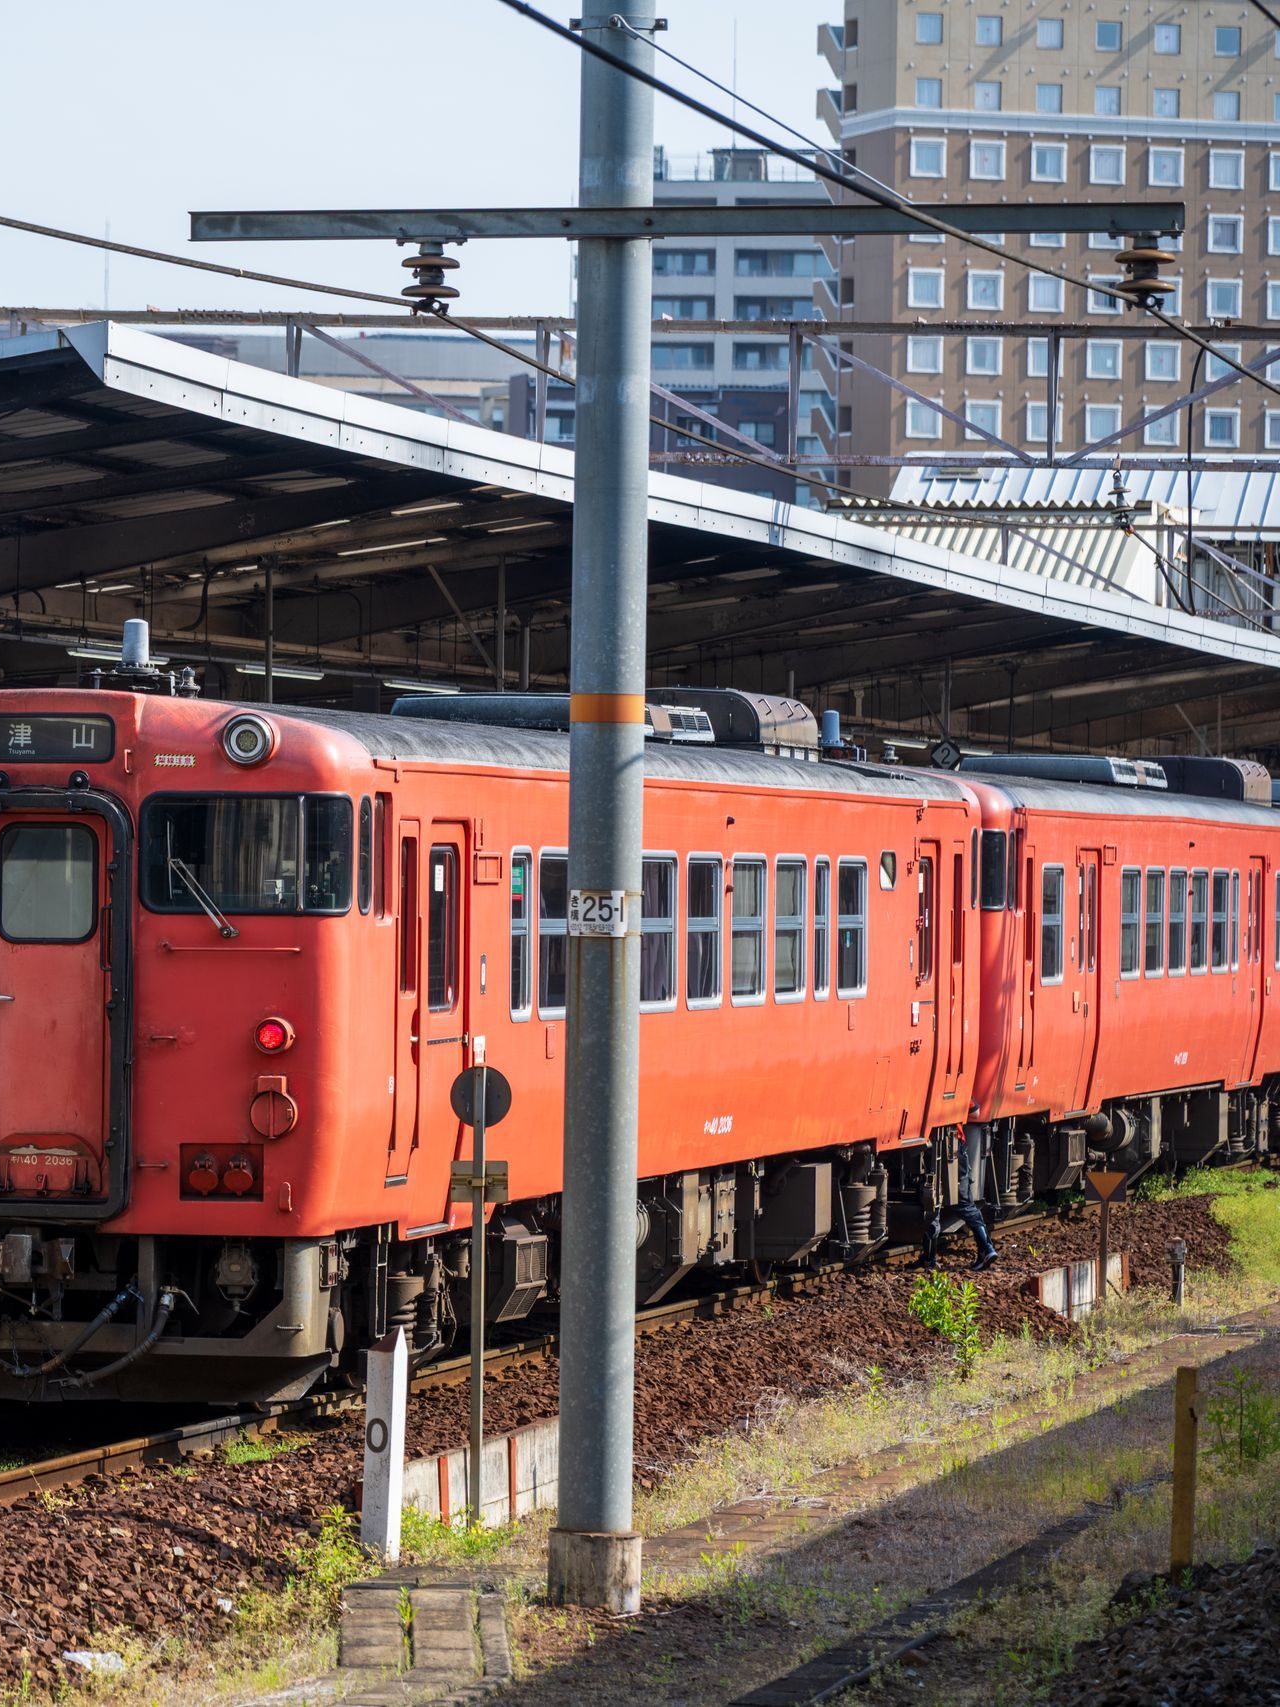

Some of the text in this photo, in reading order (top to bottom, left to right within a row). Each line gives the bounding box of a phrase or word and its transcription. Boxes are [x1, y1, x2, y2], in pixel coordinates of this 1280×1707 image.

[8, 723, 95, 749] 津山
[941, 747, 950, 765] 2
[582, 896, 624, 922] 25-1
[11, 1155, 73, 1165] キハ40 2036
